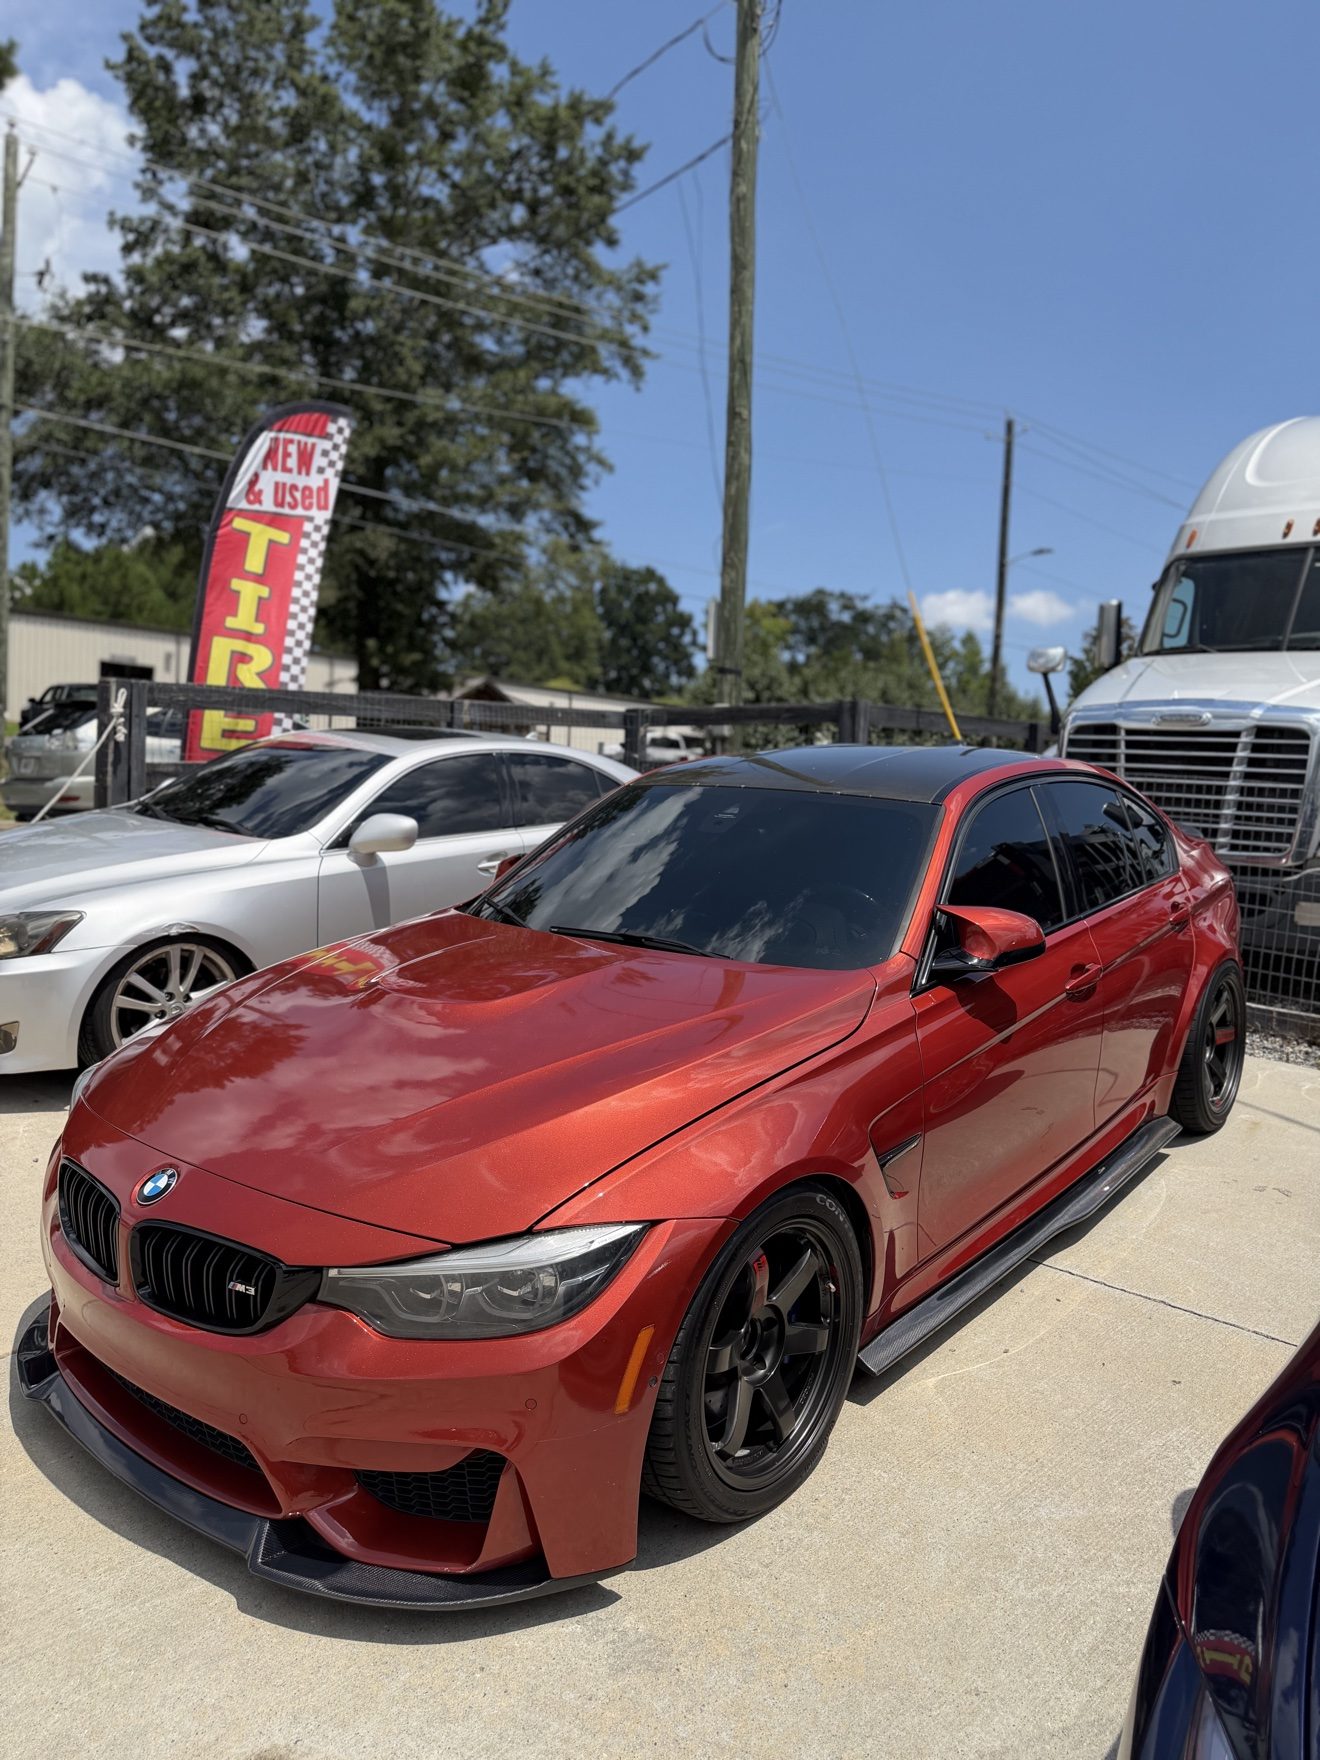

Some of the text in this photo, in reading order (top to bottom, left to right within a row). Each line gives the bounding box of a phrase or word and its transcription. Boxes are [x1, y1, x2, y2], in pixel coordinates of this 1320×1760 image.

[262, 437, 317, 476] NEW
[245, 472, 330, 511] & used
[235, 1282, 256, 1296] M3
